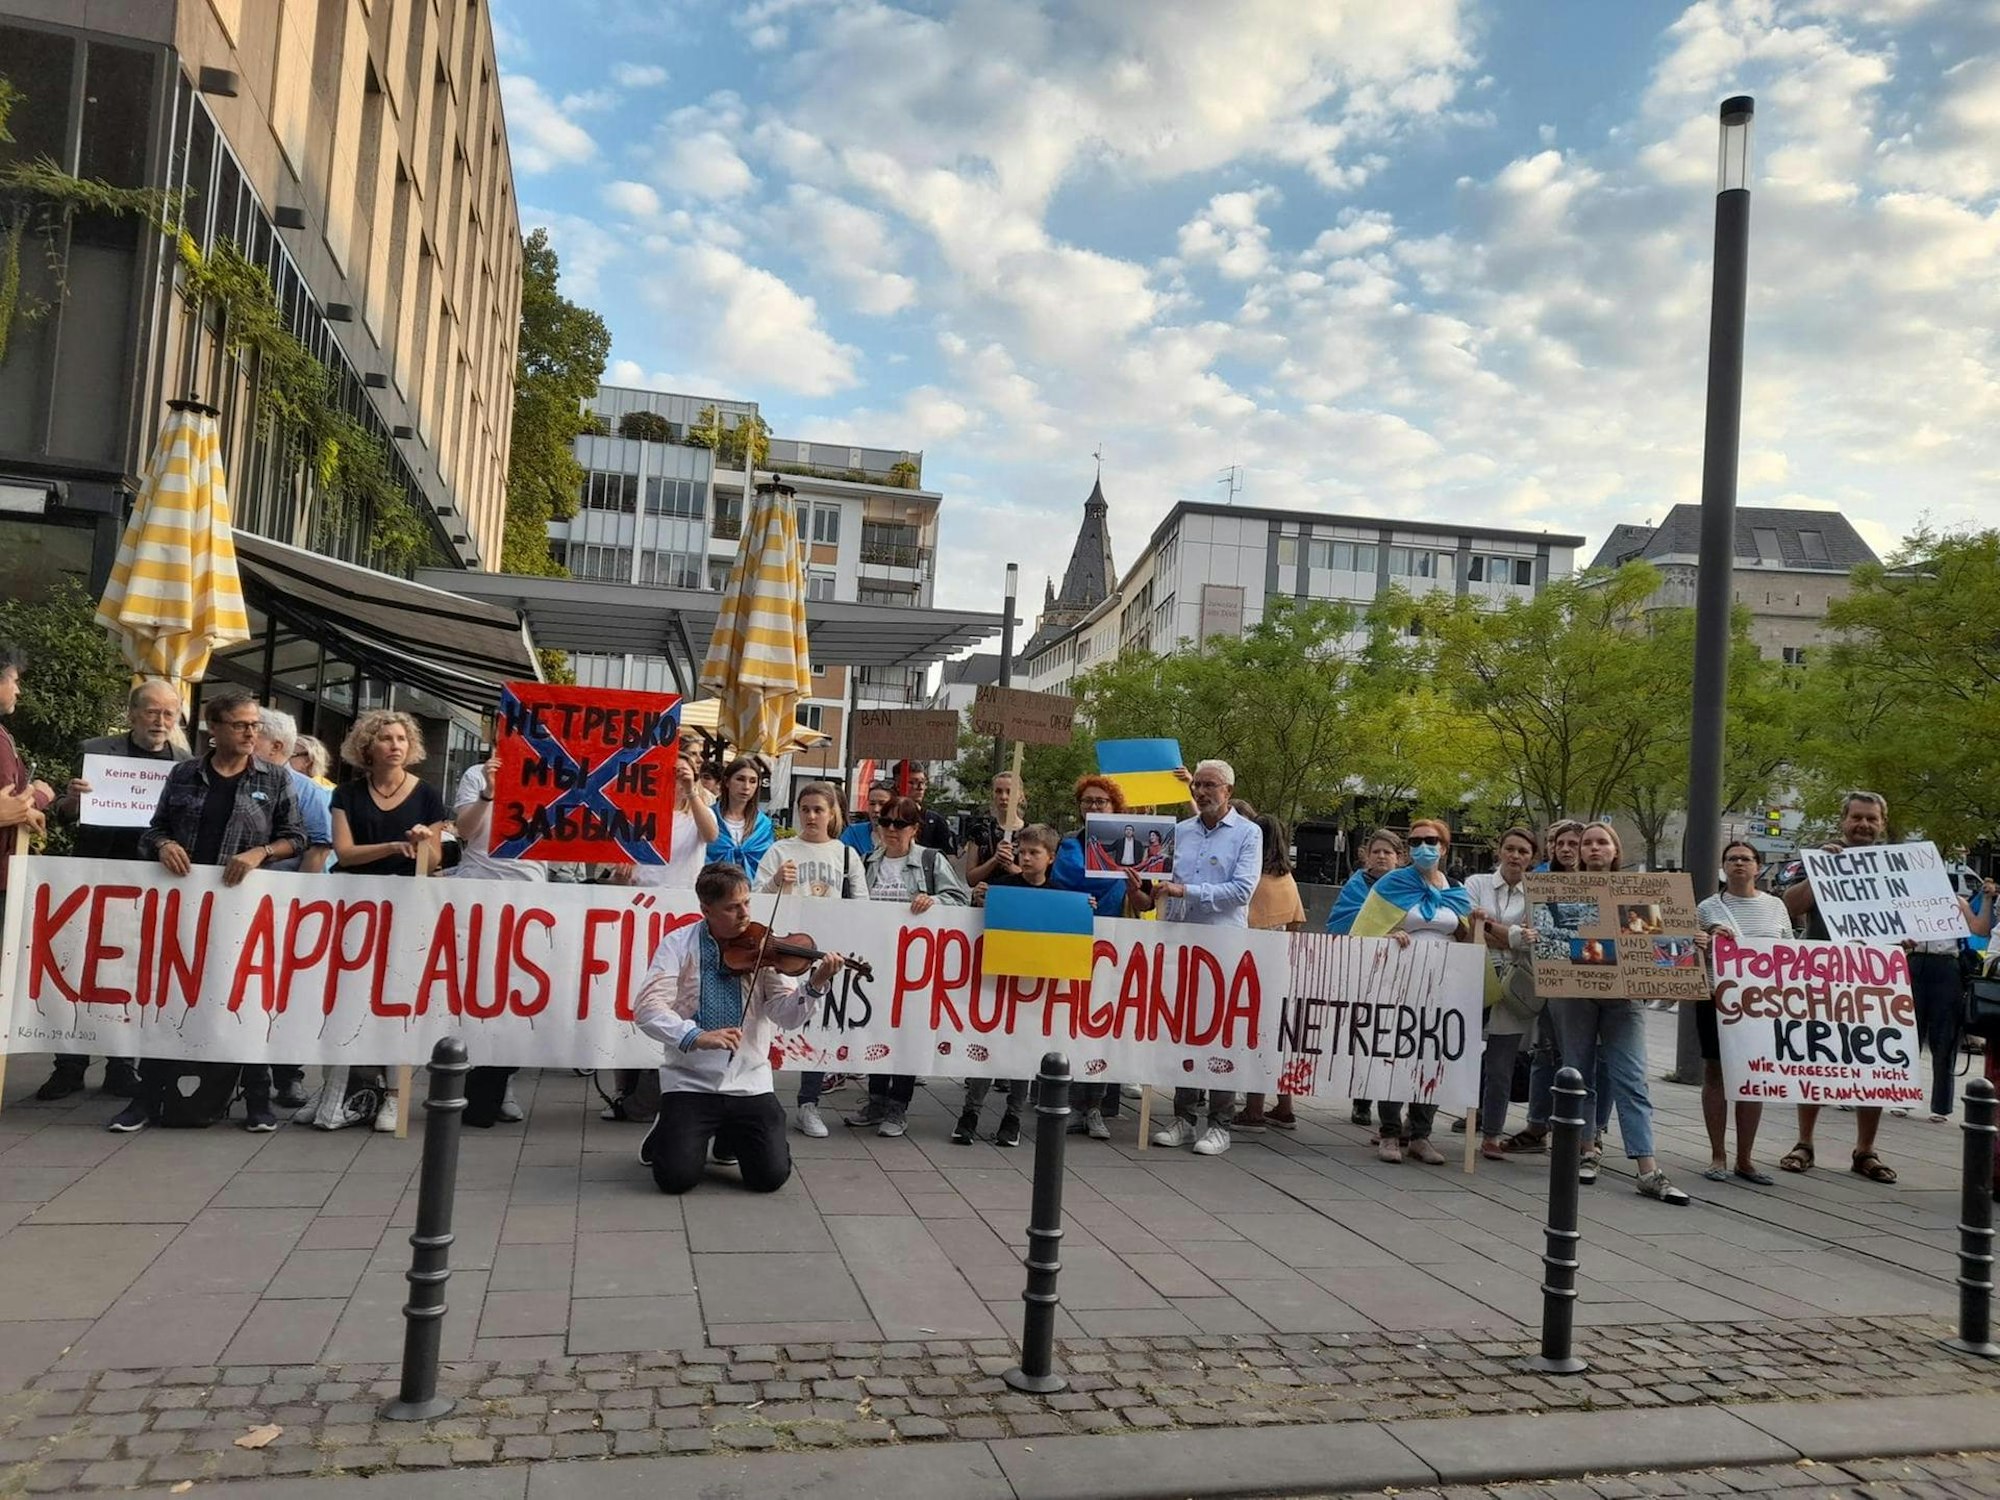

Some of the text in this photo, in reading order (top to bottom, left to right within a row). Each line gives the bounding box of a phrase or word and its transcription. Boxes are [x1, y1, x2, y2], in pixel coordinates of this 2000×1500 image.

[504, 701, 677, 748] НЕТРЕБКО
[860, 710, 892, 727] BAN
[105, 768, 169, 781] Keine Bühn
[521, 756, 659, 797] МЫ НЕ
[131, 785, 147, 795] für
[91, 798, 127, 809] Putins
[501, 801, 657, 843] ЗАБЫЛИ
[1909, 850, 1935, 870] NY
[1640, 877, 1671, 888] ANNA
[1527, 886, 1590, 895] MEINE STADT
[1660, 896, 1673, 905] AB
[1663, 907, 1688, 915] NACH
[1828, 904, 1963, 938] WARUM hier?
[1620, 938, 1648, 949] UND
[29, 883, 214, 1008] KEIN
[227, 894, 556, 1018] APPLAUS
[890, 925, 1261, 1050] PROPAGANDA
[1278, 997, 1465, 1061] NETREBKO
[1538, 968, 1558, 978] UND
[1538, 977, 1564, 987] DORT
[1779, 1063, 1861, 1079] VERGESSEN
